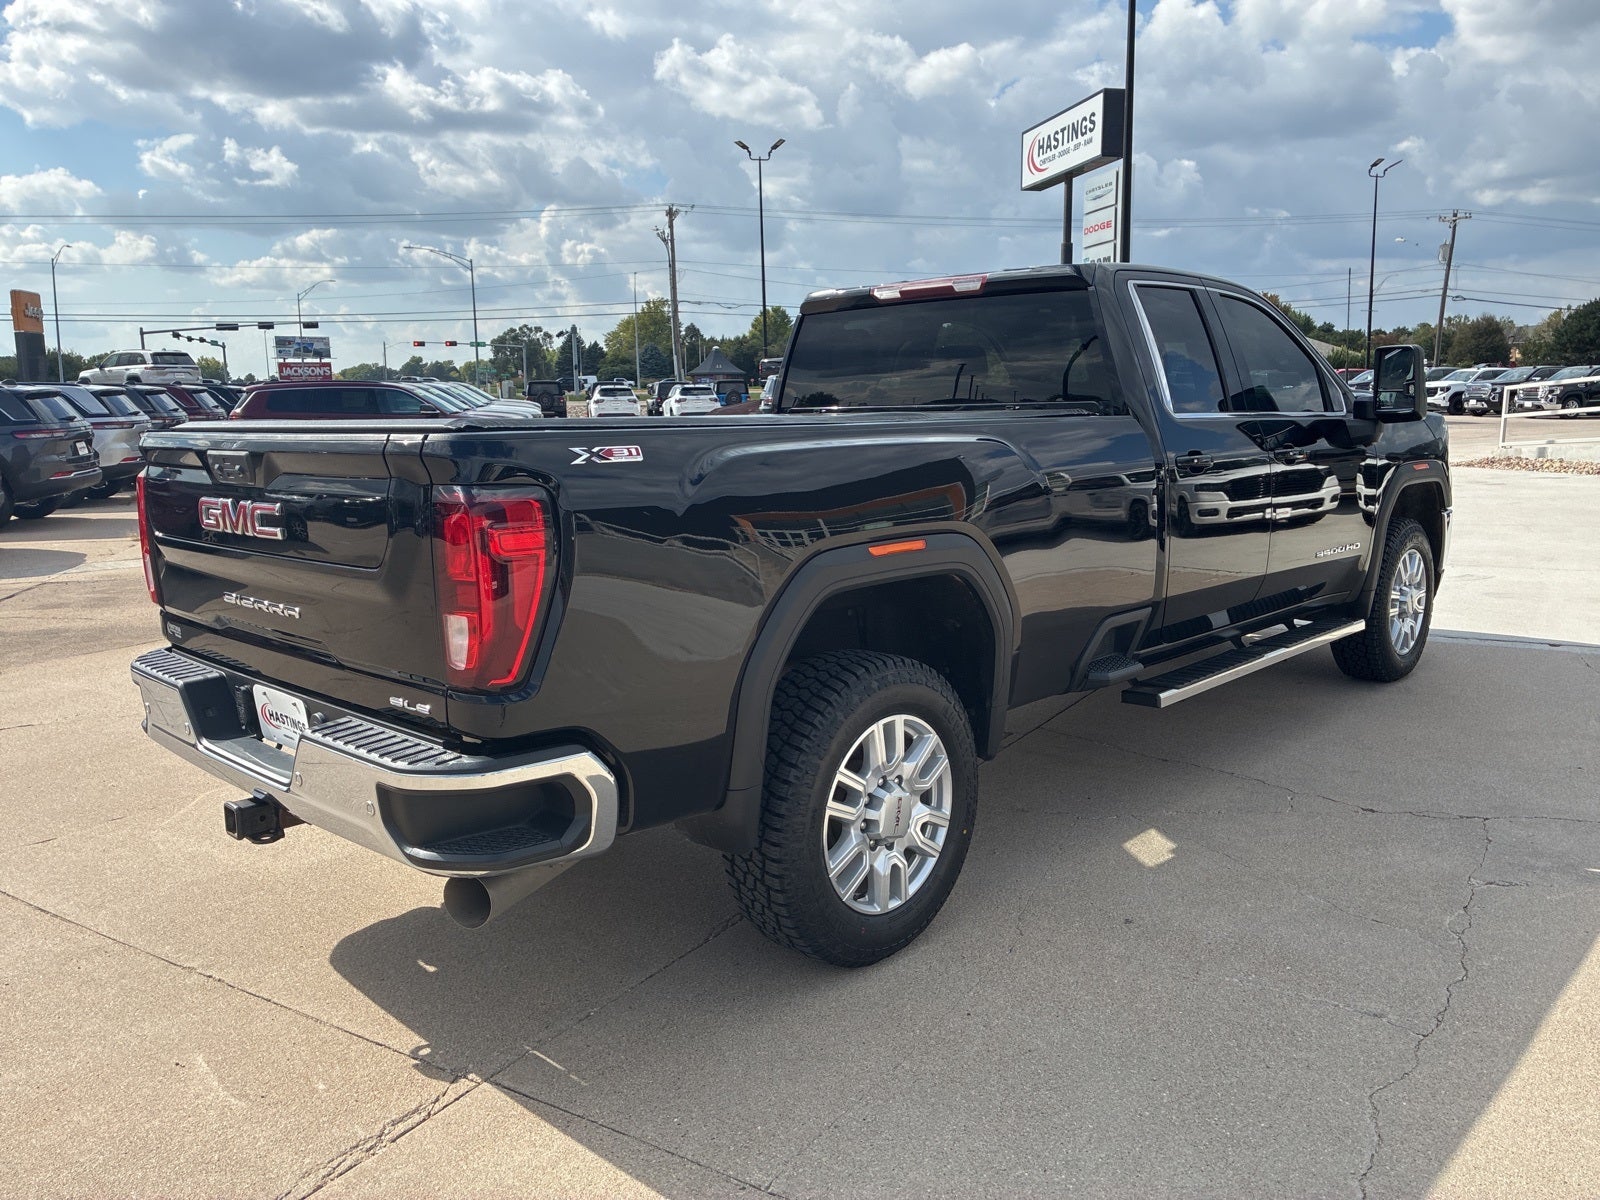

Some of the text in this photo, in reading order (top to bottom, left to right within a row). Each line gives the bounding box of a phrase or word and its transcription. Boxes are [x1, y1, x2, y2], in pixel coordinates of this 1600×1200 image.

[1037, 111, 1096, 158] HASTINGS
[1039, 137, 1093, 166] CHRYSLER DODGE JEEP RAM
[1085, 181, 1113, 195] CHRYSLER
[1084, 220, 1112, 235] DODGE
[24, 302, 44, 320] Jeep
[280, 366, 331, 377] JACKSON'S
[198, 496, 286, 541] GMC
[223, 591, 300, 619] SIERRA
[389, 696, 431, 715] SLE
[267, 708, 307, 733] HASTINGS
